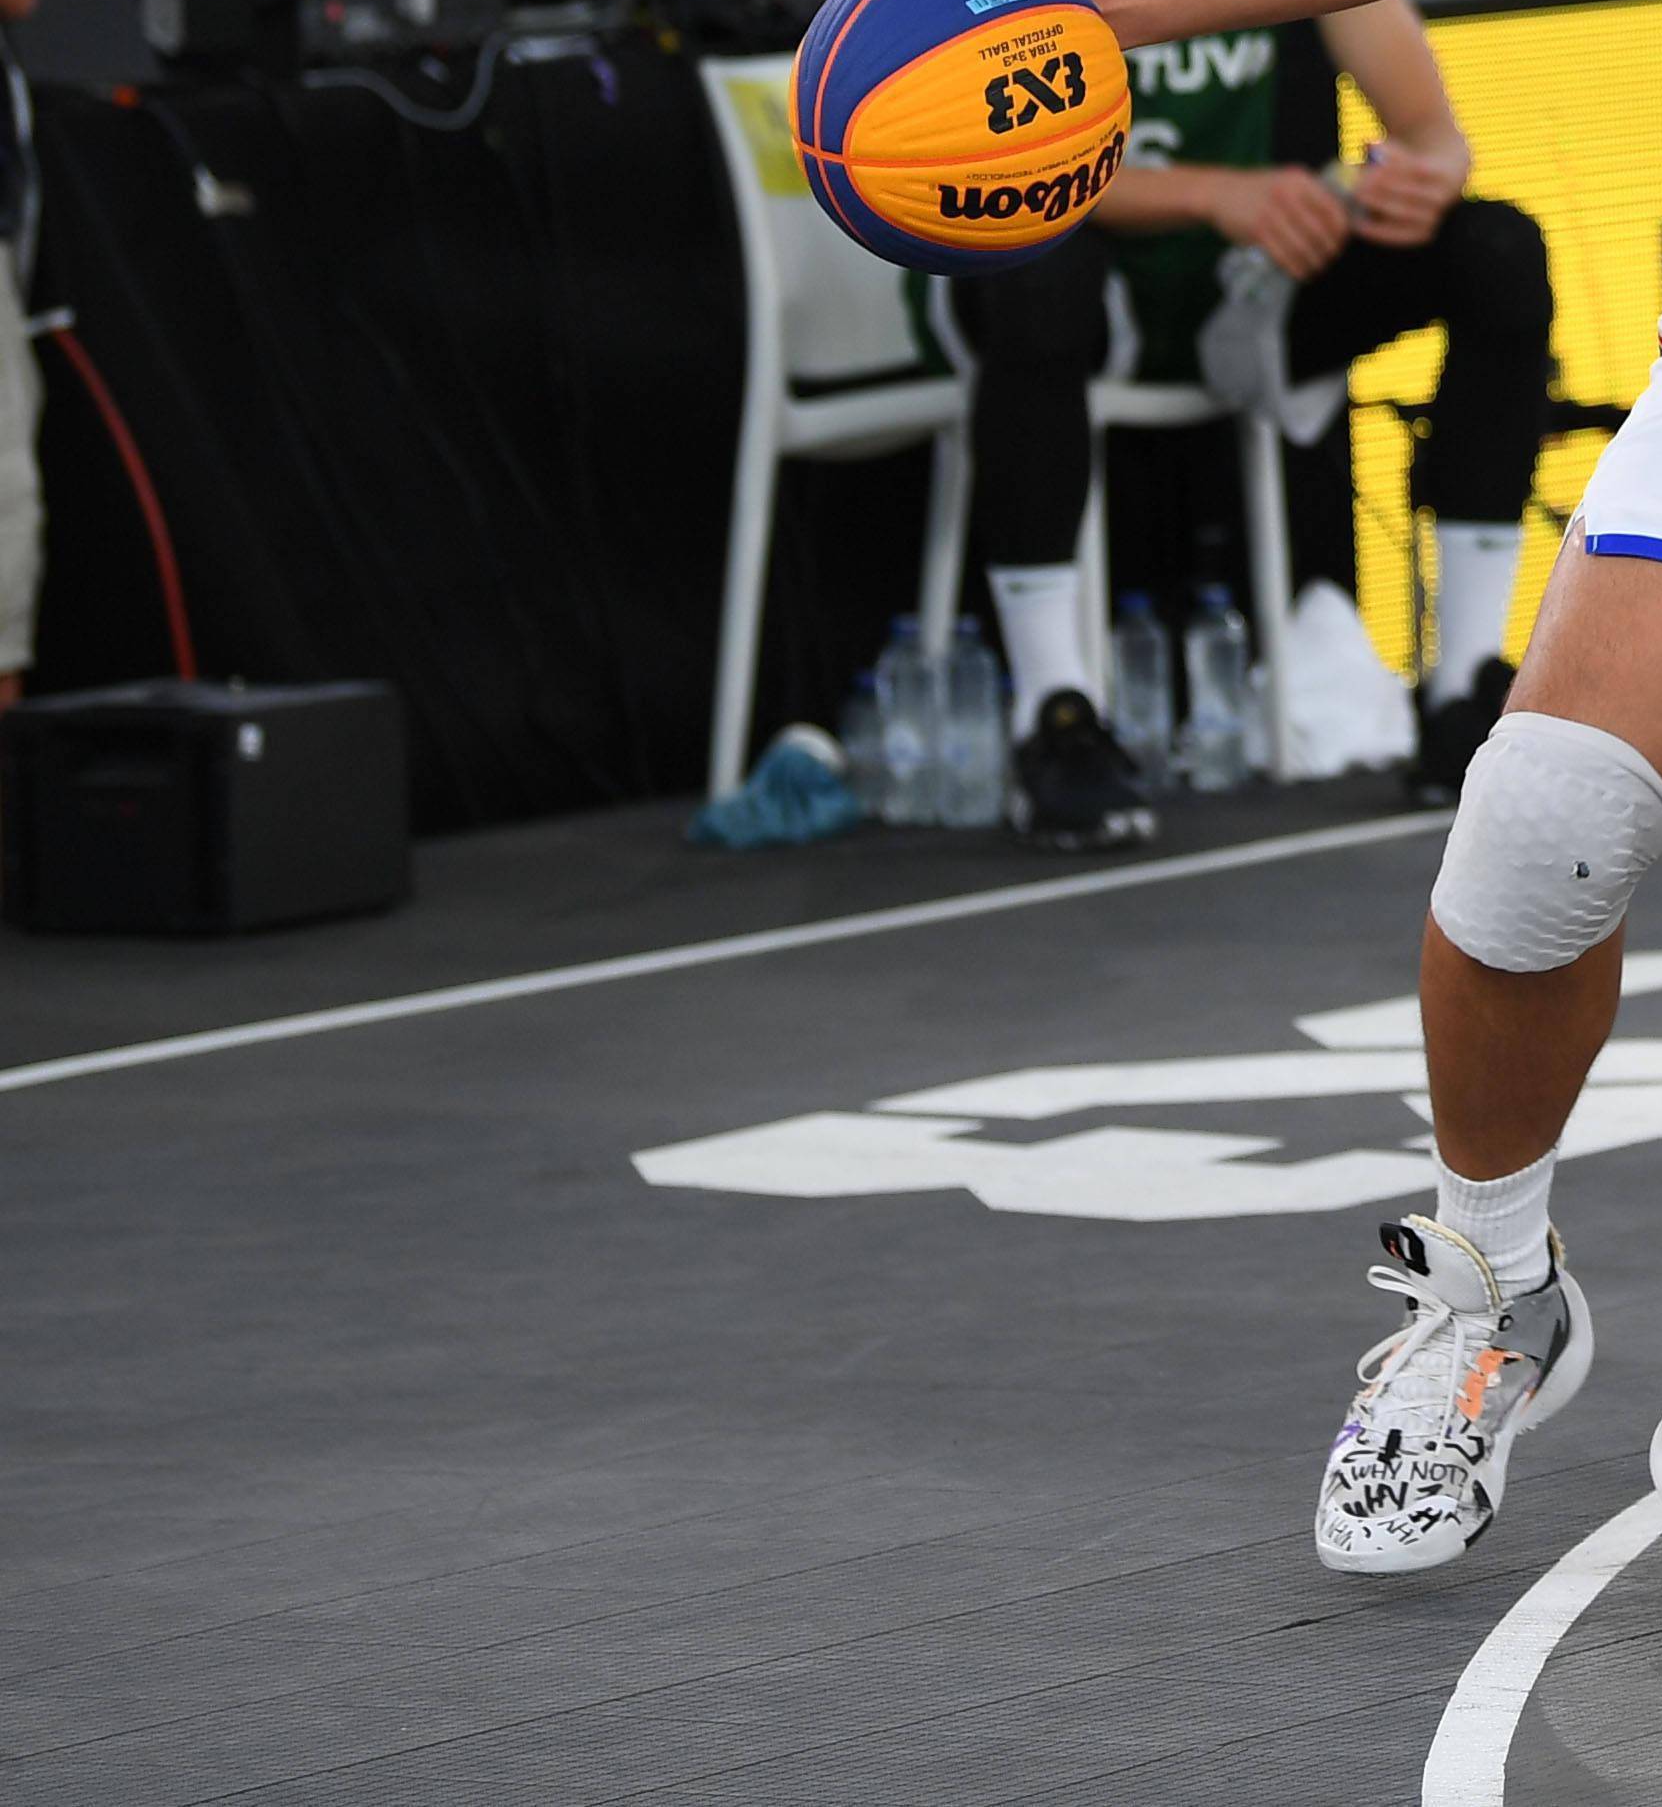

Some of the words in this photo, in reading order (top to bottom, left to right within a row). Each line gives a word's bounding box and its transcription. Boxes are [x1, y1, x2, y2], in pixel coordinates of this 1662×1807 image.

[1011, 23, 1064, 48] OFFICIAL
[978, 42, 1009, 60] BALL
[1029, 40, 1057, 59] FIBA
[939, 132, 1125, 222] Wilson
[1351, 1460, 1403, 1481] WHY
